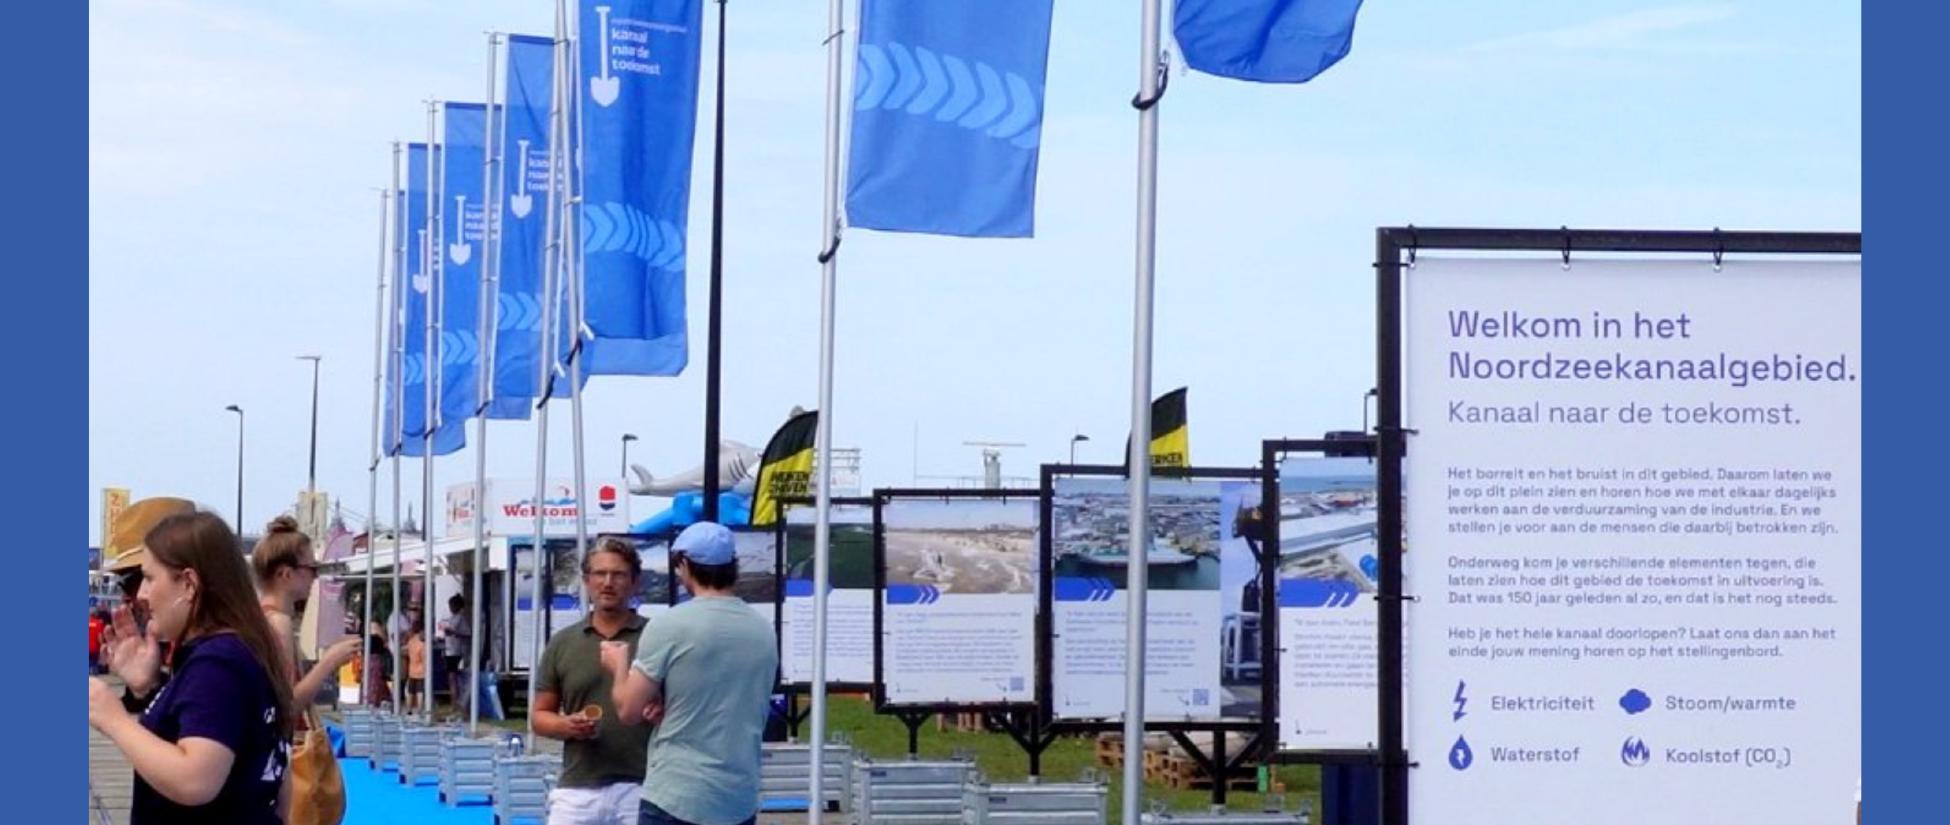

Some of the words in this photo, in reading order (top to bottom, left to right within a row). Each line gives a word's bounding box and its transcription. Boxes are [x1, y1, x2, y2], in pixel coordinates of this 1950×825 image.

[1448, 310, 1581, 339] Welkom
[1593, 311, 1622, 339] in
[1634, 311, 1691, 339] het
[1449, 351, 1856, 388] Noordzeekanaalgebied.
[1449, 400, 1539, 424] Kanaal
[1549, 407, 1610, 424] naar
[1618, 401, 1652, 424] de
[1660, 401, 1801, 425] toekomst.
[1448, 466, 1472, 480] Het
[1527, 470, 1546, 480] en
[1549, 467, 1572, 480] het
[1576, 467, 1618, 480] bruist
[1622, 468, 1635, 480] in
[1638, 468, 1657, 480] dit
[1660, 467, 1713, 483] gebied.
[1717, 467, 1770, 481] Daarom
[1773, 468, 1809, 481] laten
[1812, 471, 1832, 481] we
[1447, 484, 1460, 500] je
[1463, 488, 1482, 499] op
[1486, 485, 1505, 497] dit
[1510, 485, 1544, 499] plein
[1547, 485, 1576, 497] zien
[1579, 488, 1597, 497] en
[1600, 485, 1641, 498] horen
[1645, 486, 1671, 498] hoe
[1675, 488, 1694, 497] we
[1698, 486, 1725, 497] met
[1448, 503, 1499, 515] werken
[1502, 506, 1528, 515] aan
[1531, 503, 1550, 515] de
[1553, 503, 1657, 518] verduurzaming
[1661, 506, 1686, 515] van
[1690, 504, 1708, 516] de
[1712, 504, 1777, 516] industrie.
[1781, 504, 1797, 516] En
[1801, 507, 1821, 516] we
[1448, 520, 1496, 533] stellen
[1498, 522, 1512, 536] je
[1515, 523, 1546, 533] voor
[1550, 523, 1576, 533] aan
[1579, 521, 1598, 533] de
[1600, 523, 1656, 533] mensen
[1659, 521, 1681, 533] die
[1736, 521, 1807, 534] betrokken
[1810, 521, 1839, 536] zijn.
[1448, 555, 1520, 571] Onderweg
[1523, 556, 1553, 569] kom
[1555, 556, 1568, 571] je
[1669, 557, 1742, 569] elementen
[1745, 557, 1791, 571] tegen,
[1794, 556, 1816, 569] die
[1448, 574, 1484, 586] laten
[1488, 574, 1516, 586] zien
[1520, 574, 1546, 586] hoe
[1550, 574, 1569, 586] dit
[1573, 574, 1622, 589] gebied
[1625, 574, 1643, 586] de
[1647, 574, 1713, 586] toekomst
[1717, 574, 1730, 586] in
[1808, 575, 1824, 586] is.
[1448, 591, 1472, 604] Dat
[1476, 594, 1504, 604] was
[1507, 591, 1532, 604] 150
[1534, 592, 1562, 607] jaar
[1565, 592, 1623, 607] geleden
[1626, 592, 1638, 604] al
[1641, 594, 1662, 605] zo,
[1664, 594, 1682, 604] en
[1686, 592, 1709, 604] dat
[1713, 592, 1725, 604] is
[1728, 592, 1752, 604] het
[1755, 595, 1782, 607] nog
[1786, 592, 1838, 604] steeds.
[1448, 626, 1476, 640] Heb
[1479, 626, 1492, 642] je
[1496, 627, 1520, 640] het
[1523, 627, 1553, 640] hele
[1556, 627, 1603, 640] kanaal
[1689, 627, 1721, 640] Laat
[1724, 630, 1750, 640] ons
[1753, 627, 1780, 640] dan
[1783, 630, 1809, 640] aan
[1812, 627, 1836, 640] het
[1448, 645, 1488, 657] einde
[1490, 645, 1525, 661] jouw
[1528, 645, 1581, 660] mening
[1583, 645, 1624, 657] horen
[1627, 647, 1647, 660] op
[1650, 645, 1673, 657] het
[1491, 696, 1595, 711] Elektriciteit
[1665, 695, 1797, 714] Stoom/warmte
[1490, 744, 1580, 762] Waterstof
[1666, 748, 1741, 764] Koolstof
